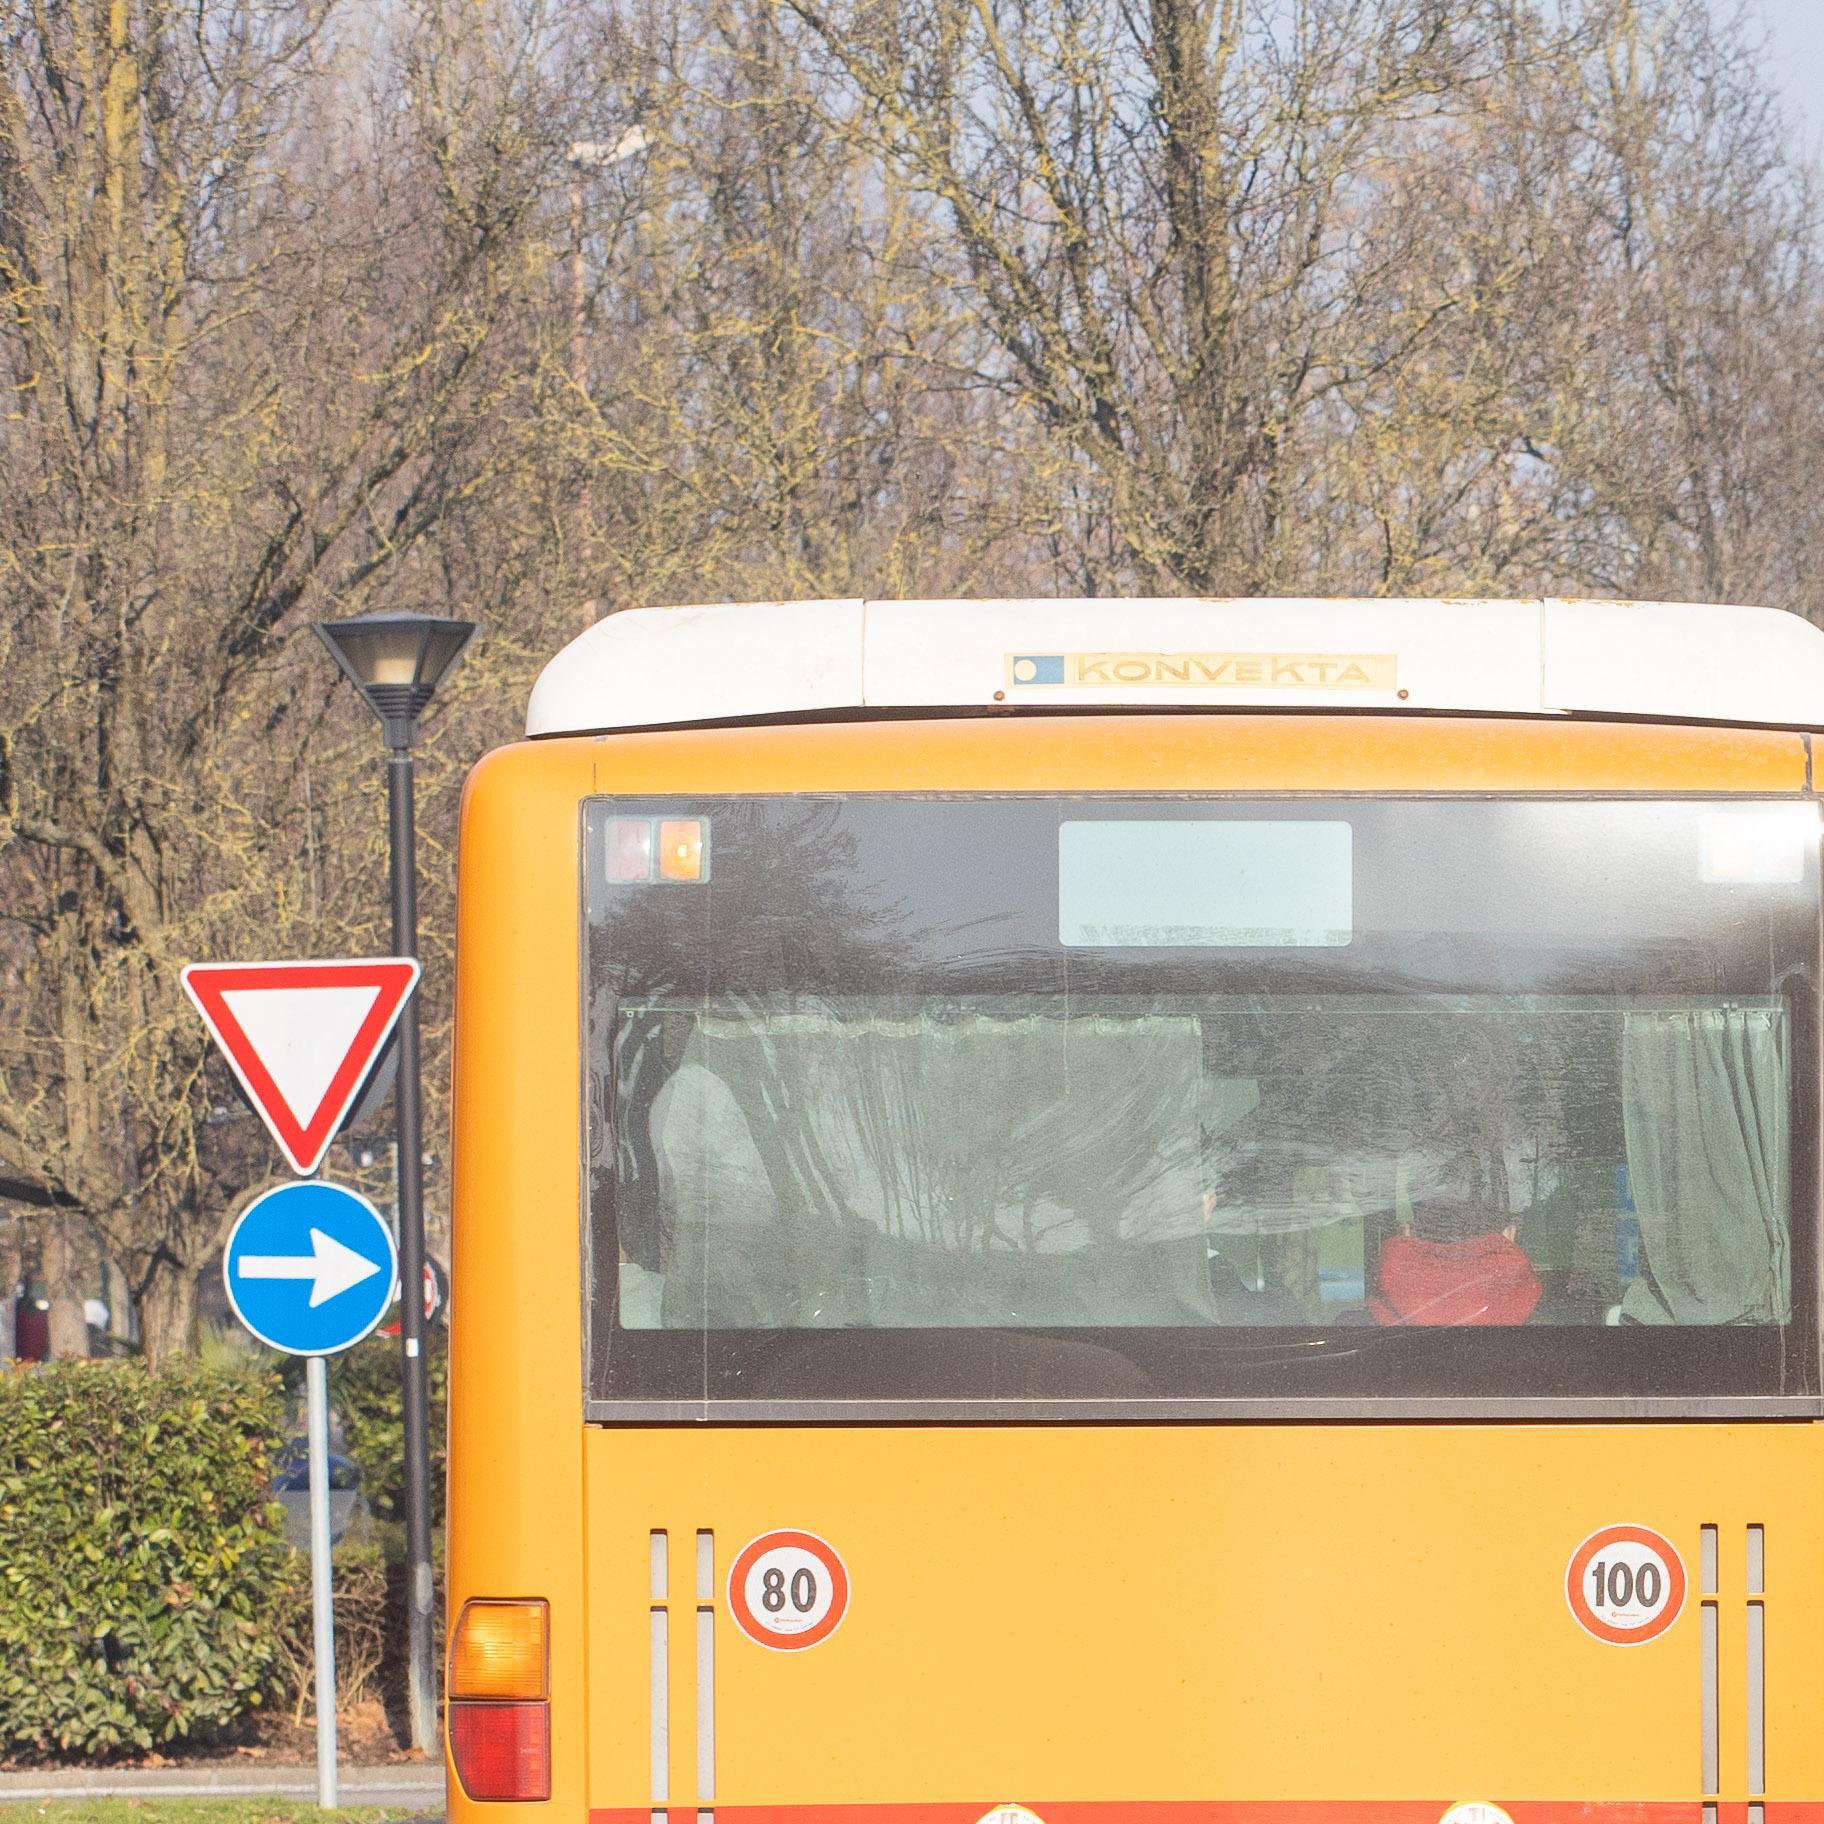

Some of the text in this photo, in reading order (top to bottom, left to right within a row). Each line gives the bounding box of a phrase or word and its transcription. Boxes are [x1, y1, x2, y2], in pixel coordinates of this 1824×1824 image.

[1077, 656, 1372, 684] KONVEKTA
[762, 1567, 817, 1613] 80
[1592, 1561, 1661, 1608] 100
